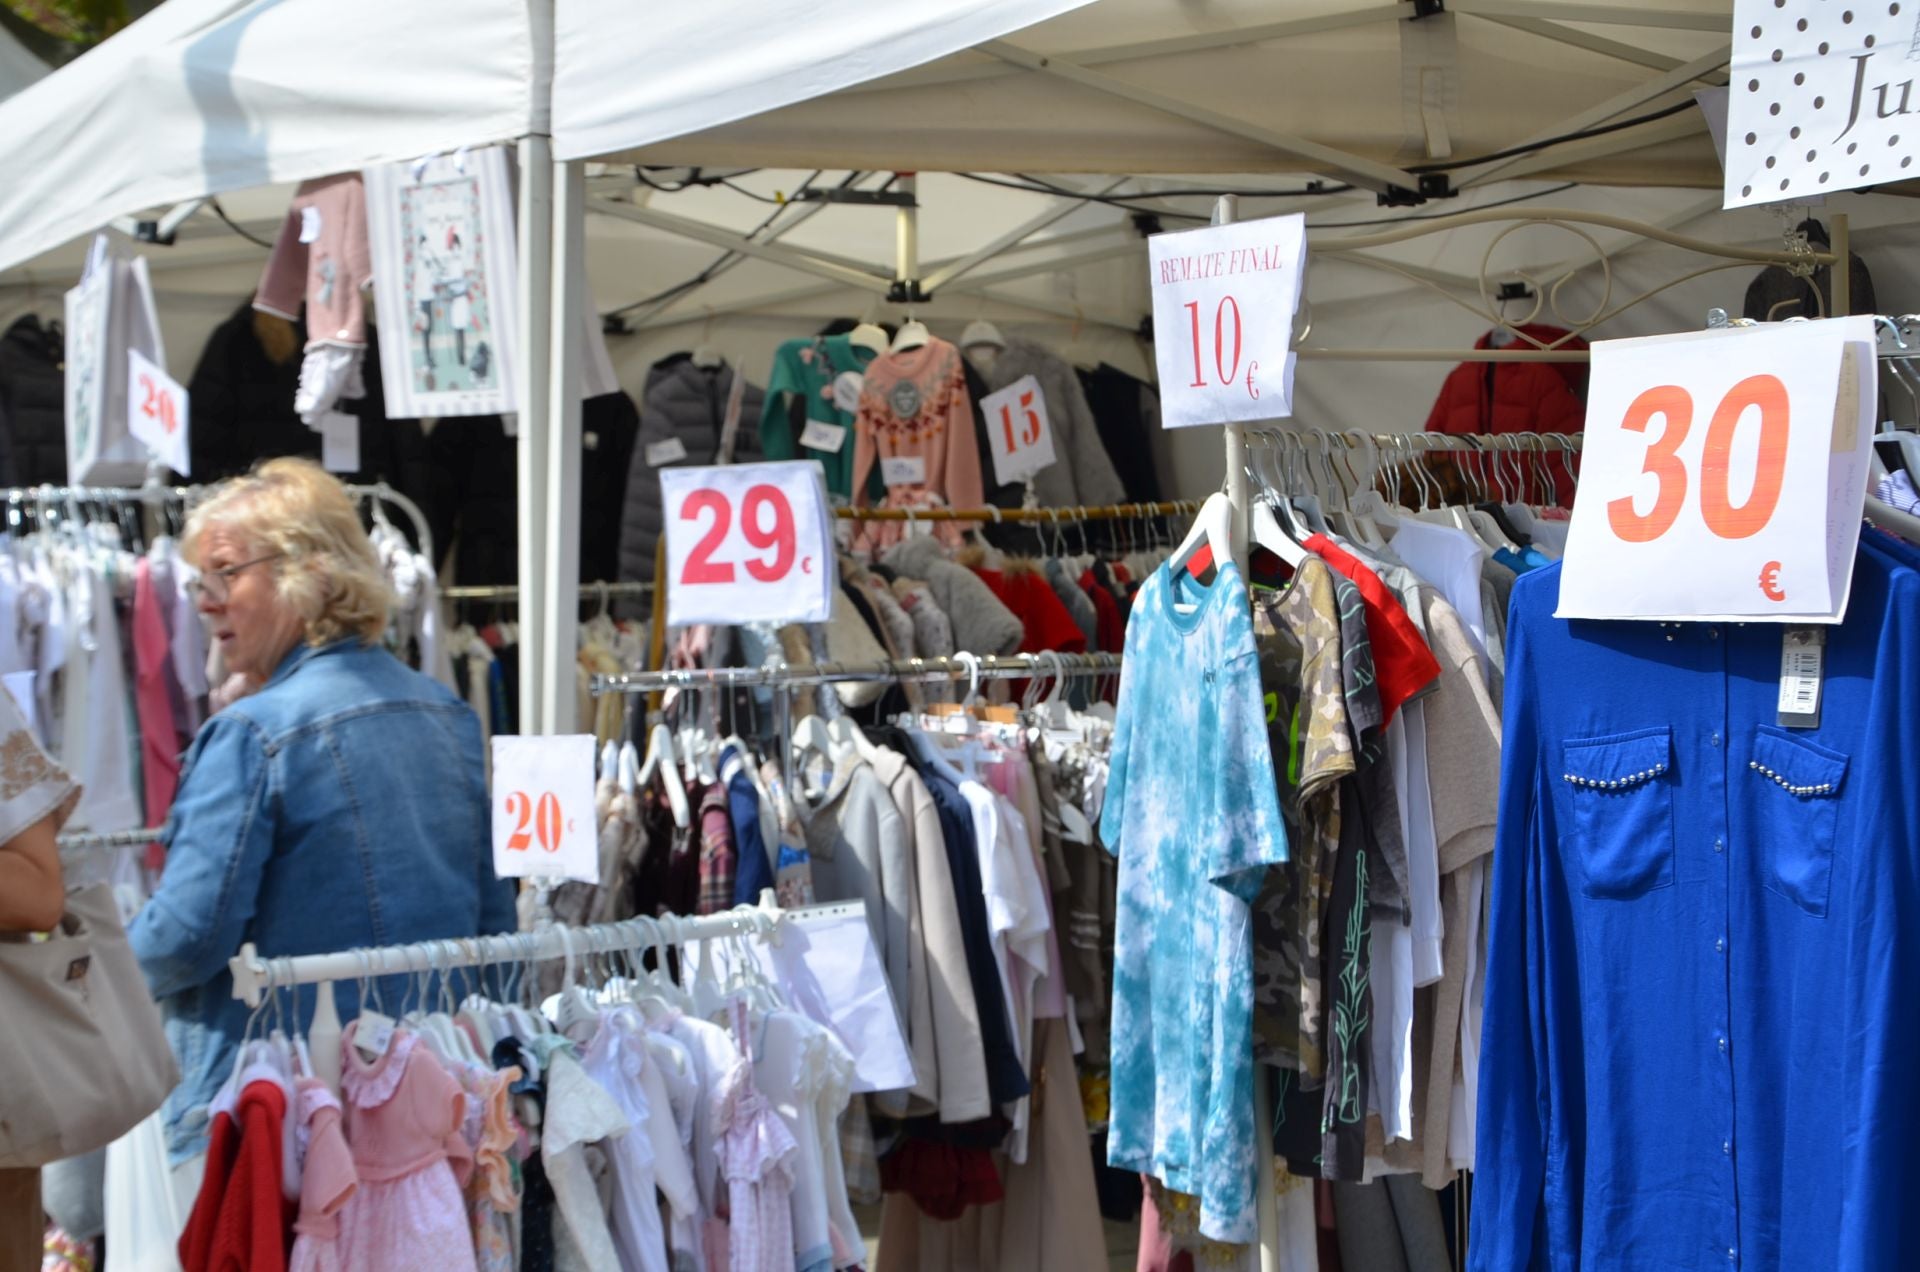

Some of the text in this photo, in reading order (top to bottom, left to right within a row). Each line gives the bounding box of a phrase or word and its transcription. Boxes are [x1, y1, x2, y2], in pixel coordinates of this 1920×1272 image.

[1832, 52, 1920, 145] Ju
[1160, 245, 1282, 285] REMATE FINAL
[140, 373, 178, 435] 20
[1000, 390, 1041, 455] 15
[1607, 374, 1790, 543] 30
[1758, 560, 1786, 602] €
